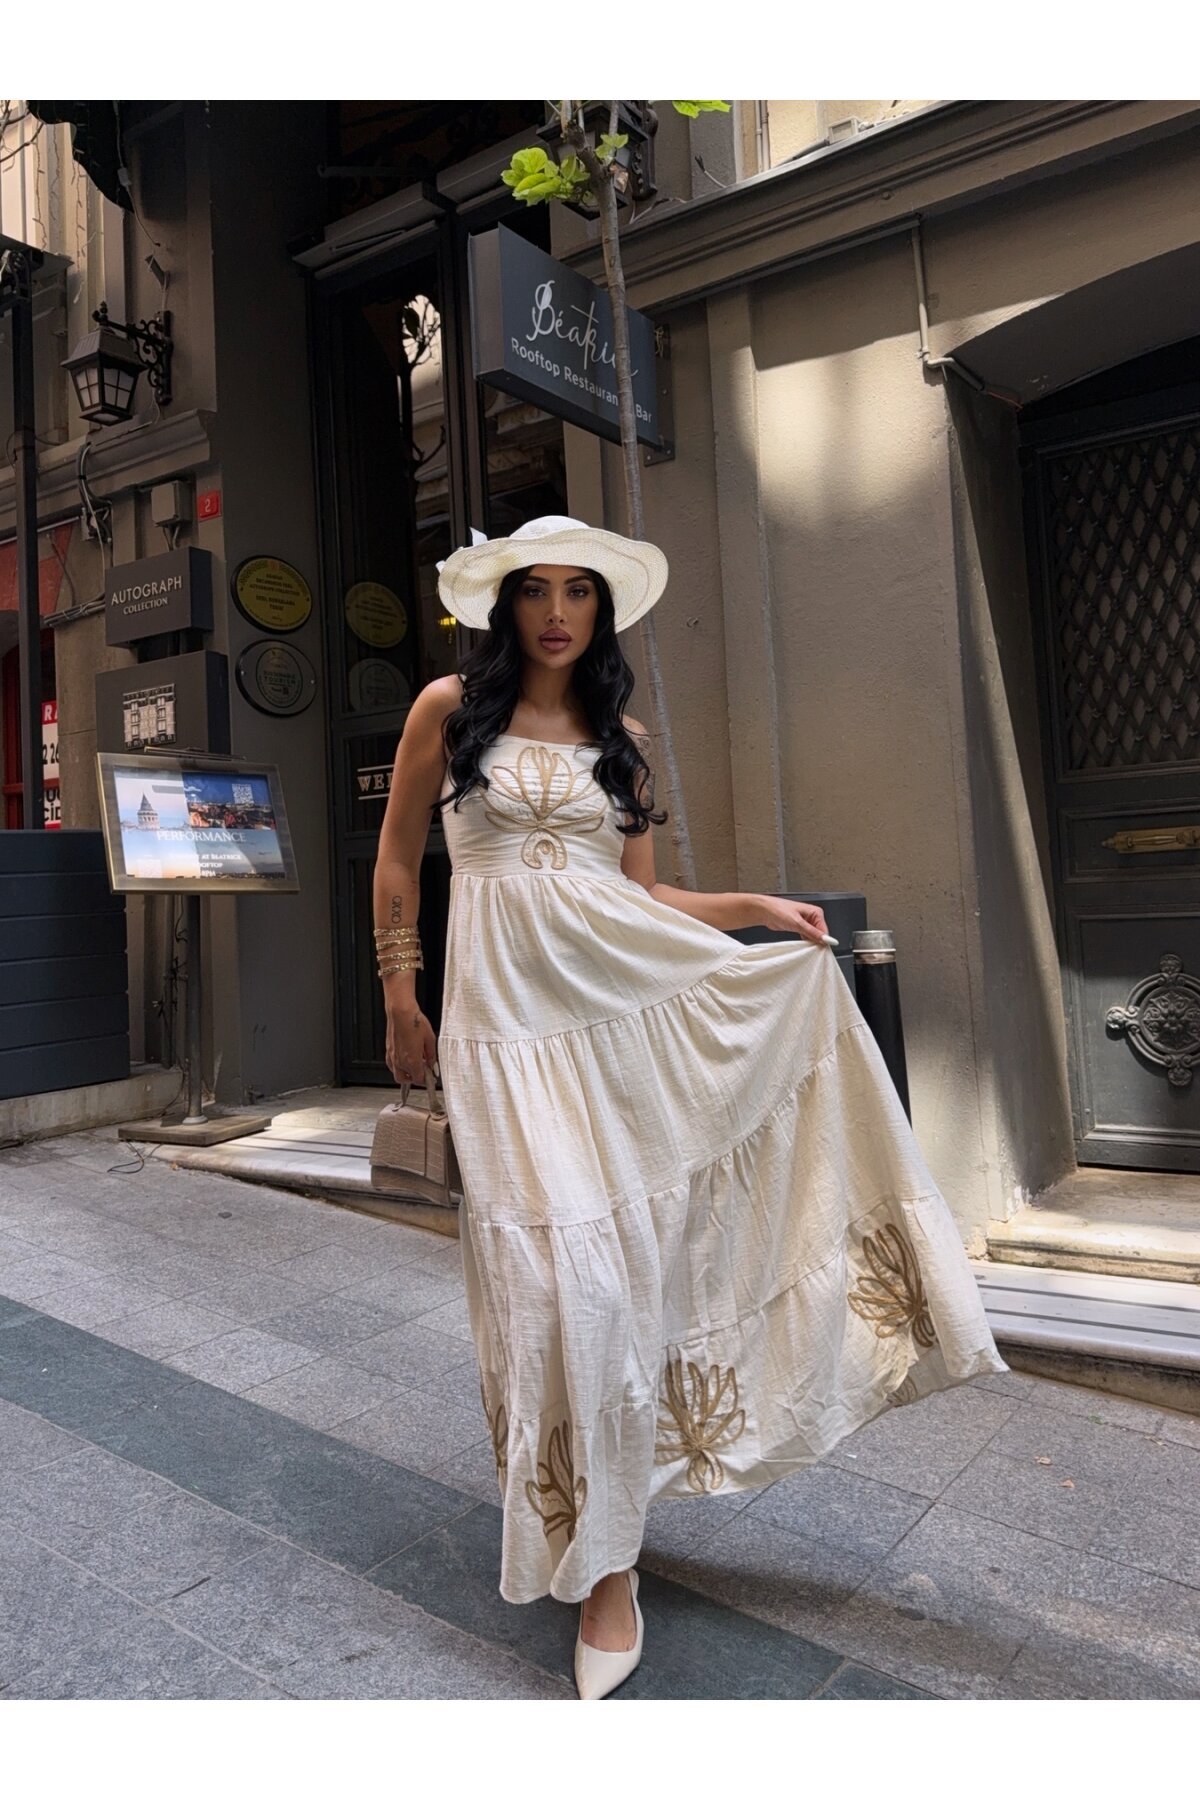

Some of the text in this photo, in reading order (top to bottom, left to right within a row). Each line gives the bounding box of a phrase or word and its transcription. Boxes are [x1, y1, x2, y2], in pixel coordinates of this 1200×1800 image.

[511, 337, 652, 423] Rooftop Restauran Bar
[205, 498, 211, 512] 2
[111, 575, 183, 606] AUTOGRAPH
[123, 597, 169, 615] COLLECTION
[156, 830, 246, 842] PERFORMANCE
